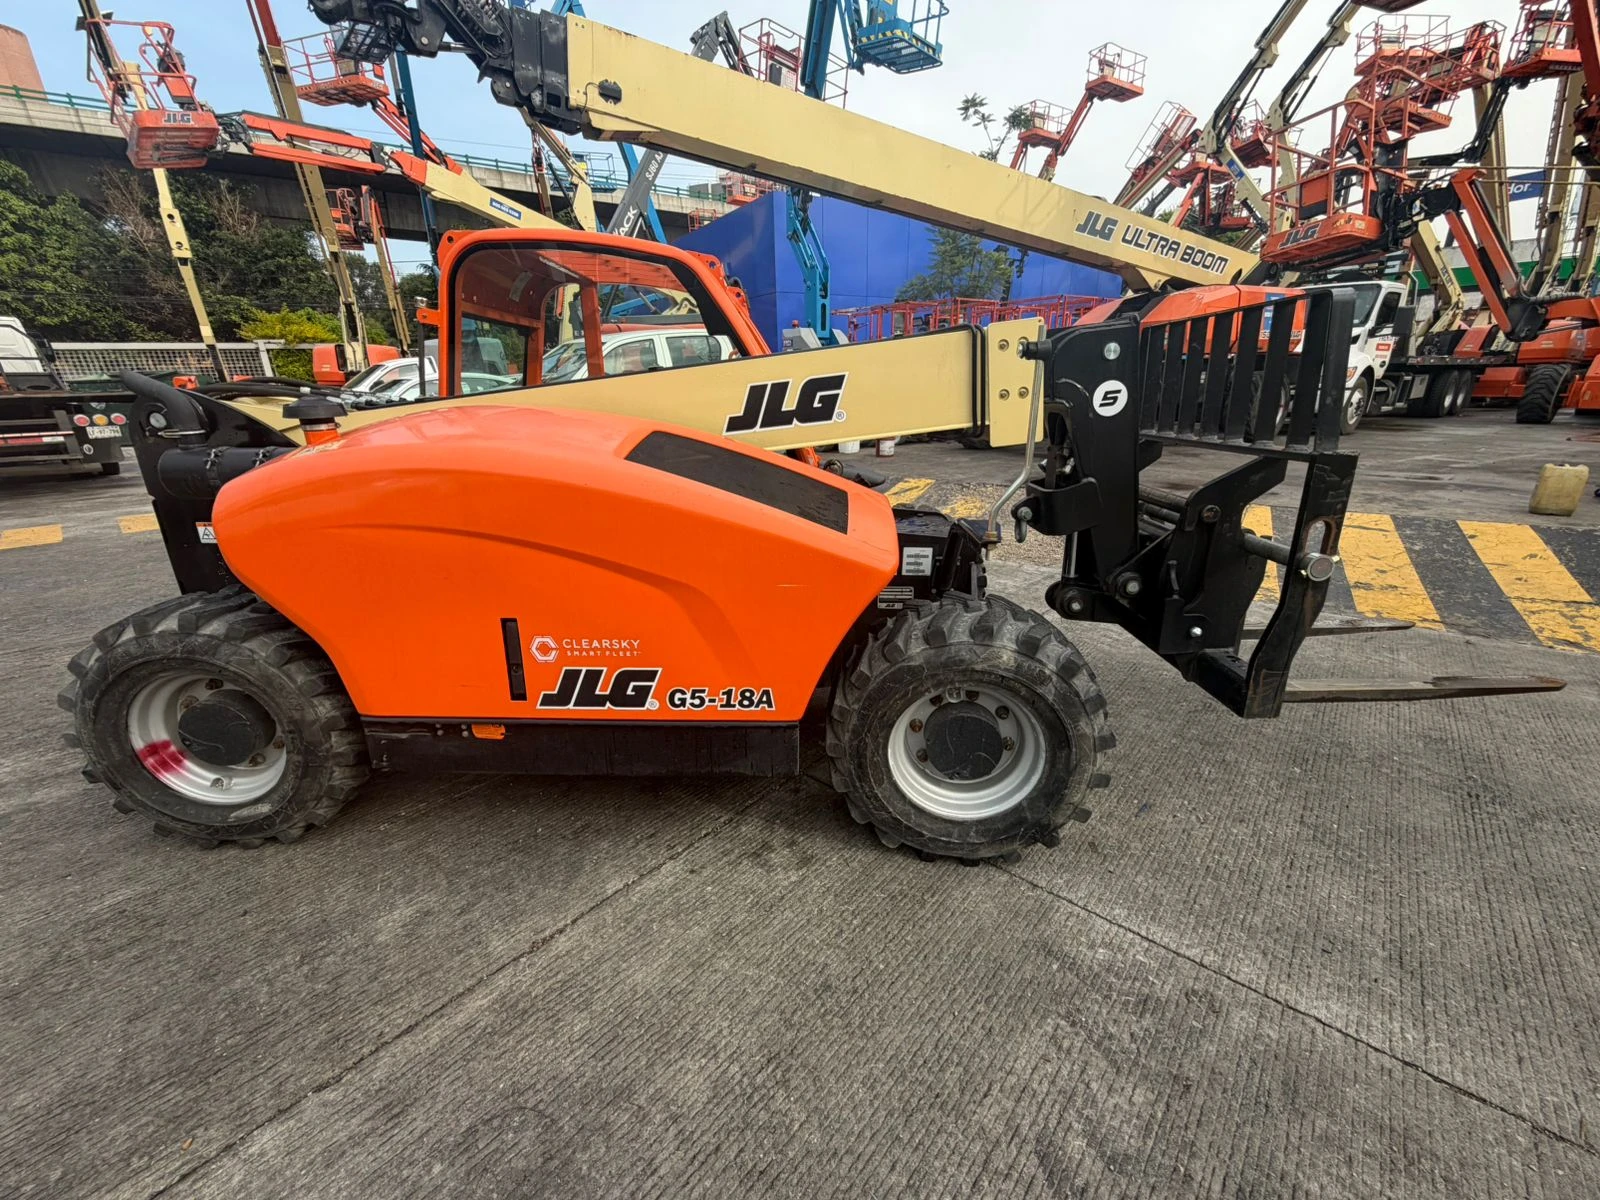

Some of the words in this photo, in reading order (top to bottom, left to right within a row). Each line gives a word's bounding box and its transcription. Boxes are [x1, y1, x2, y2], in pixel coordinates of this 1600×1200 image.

[162, 111, 195, 125] JLG
[645, 160, 660, 181] SJ60
[1075, 210, 1119, 242] JLG
[1121, 224, 1182, 260] ULTRA
[1179, 244, 1230, 275] BOOM
[1278, 221, 1321, 249] JLG
[722, 371, 849, 436] JLG
[562, 638, 641, 650] CLEARSKY
[566, 649, 602, 657] SMART
[535, 666, 663, 711] JLG
[667, 686, 776, 711] G5-18A
